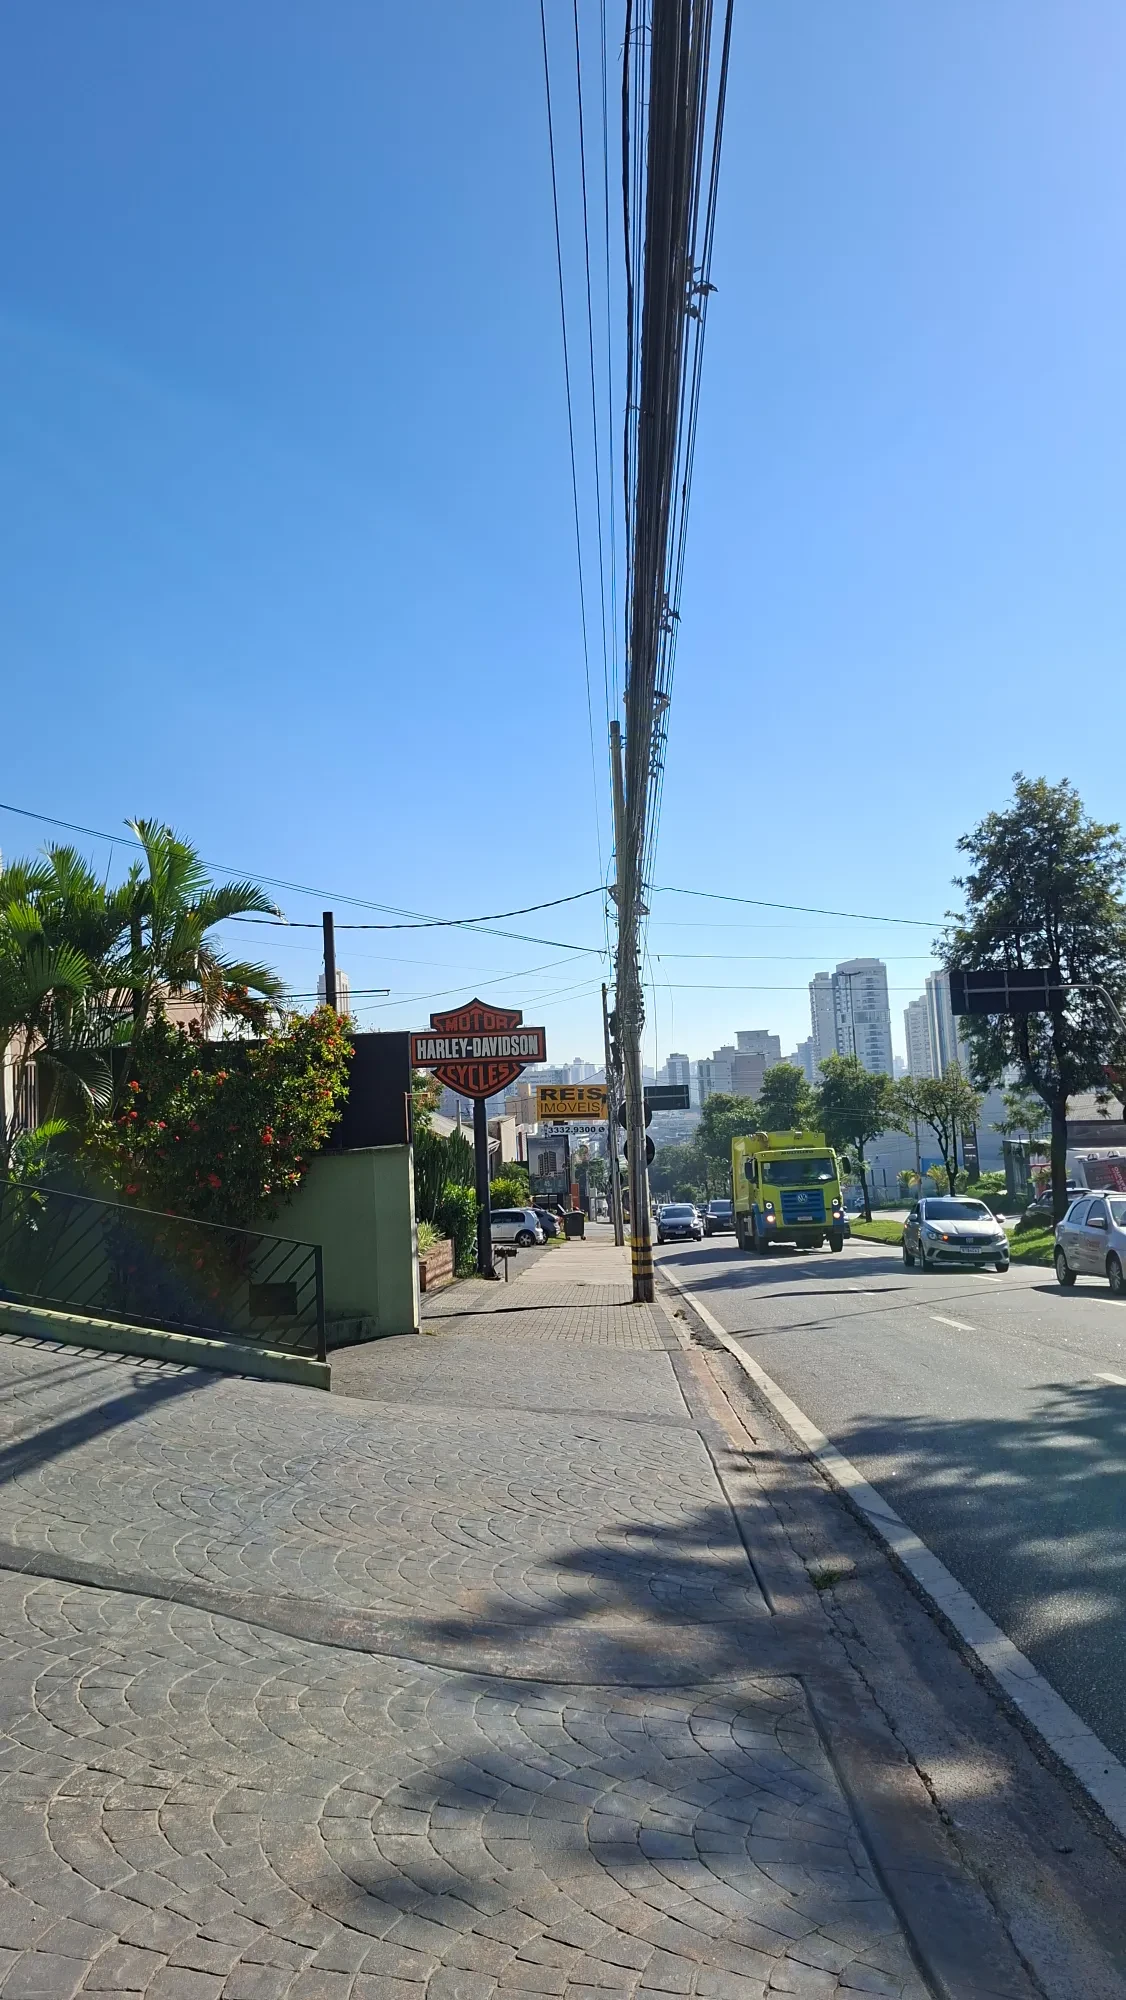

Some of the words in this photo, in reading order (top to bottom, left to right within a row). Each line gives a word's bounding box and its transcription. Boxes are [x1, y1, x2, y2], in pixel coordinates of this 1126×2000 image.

[446, 1009, 508, 1032] MOTOR
[416, 1034, 538, 1060] HARLEY-DAVIDSON
[447, 1063, 510, 1091] CYCLES
[541, 1101, 601, 1113] IMÓVEIS
[547, 1126, 597, 1134] 3332.9300
